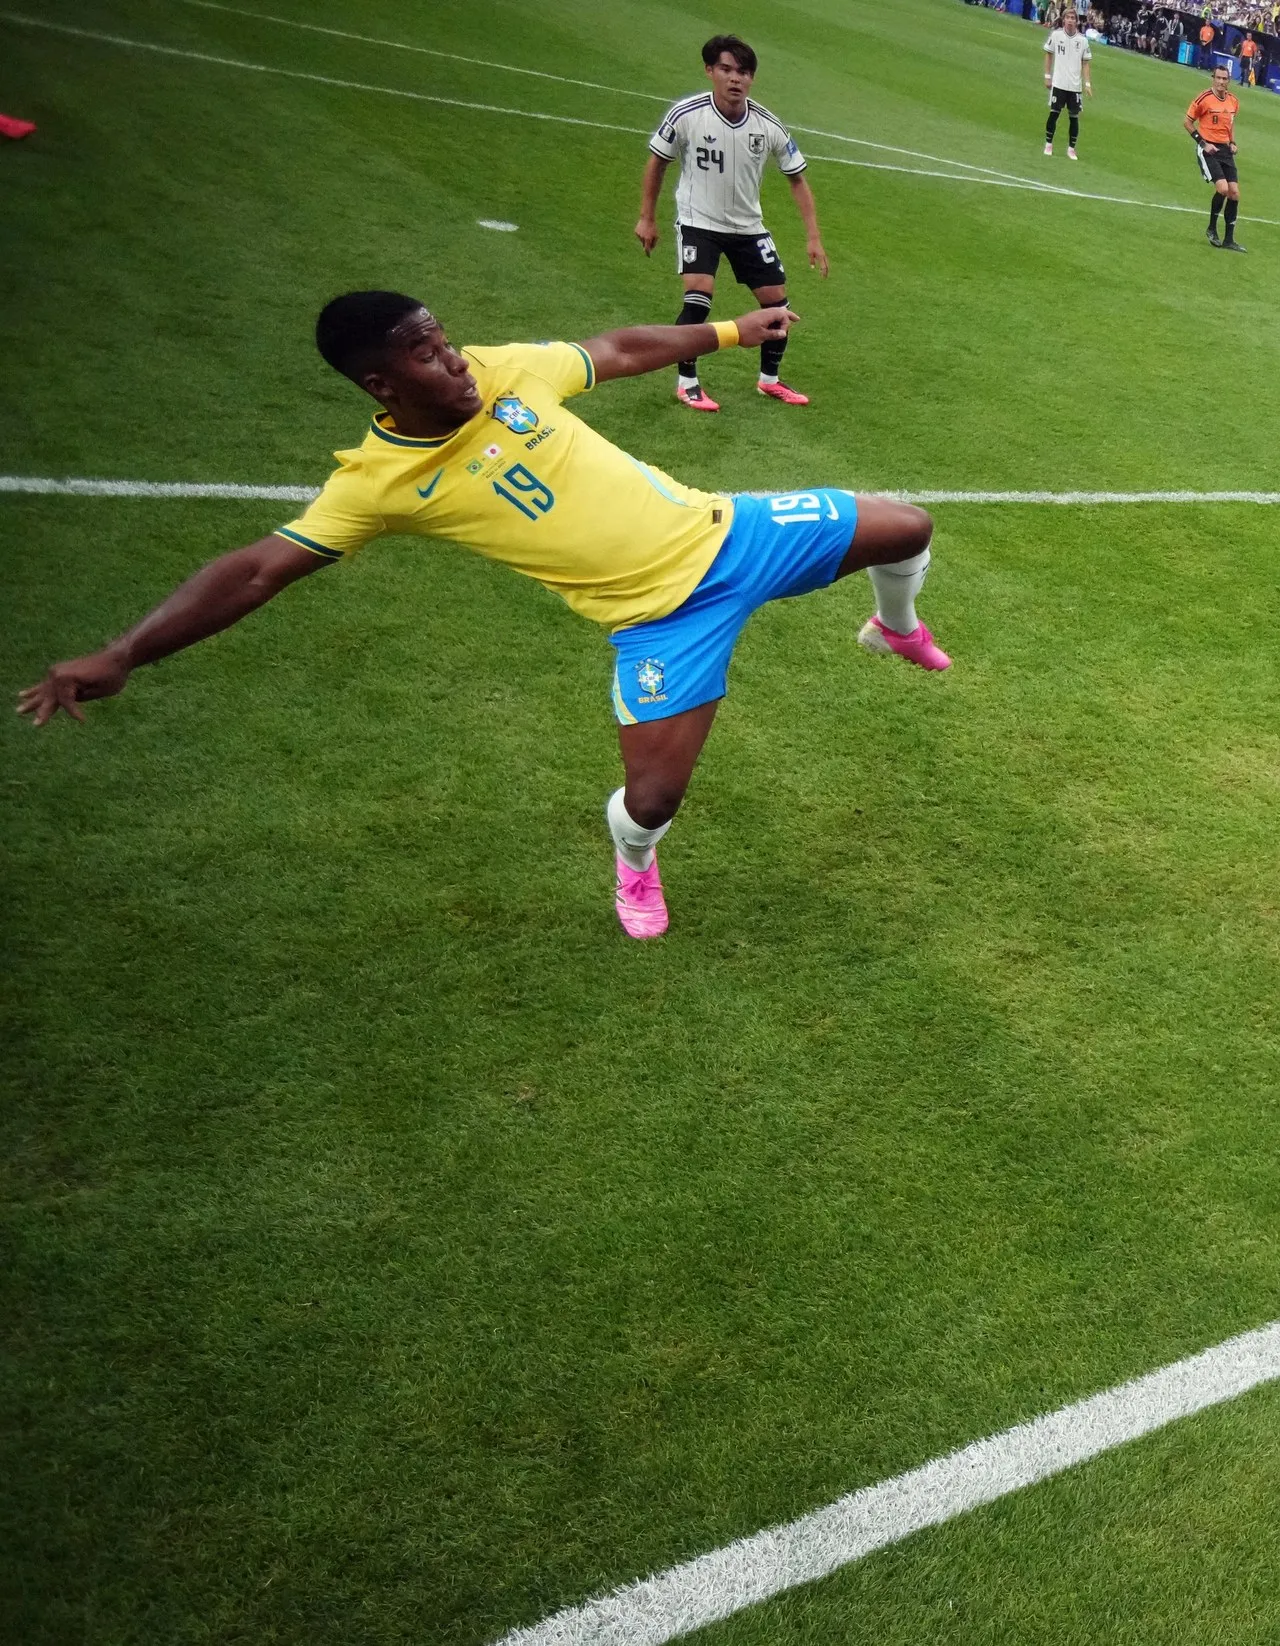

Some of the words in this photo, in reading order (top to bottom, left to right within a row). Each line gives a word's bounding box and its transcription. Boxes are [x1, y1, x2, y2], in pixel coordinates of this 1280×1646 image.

[1057, 45, 1066, 56] 14
[696, 146, 725, 174] 24
[524, 426, 556, 451] BRASIL
[492, 462, 555, 521] 19
[770, 493, 821, 527] 19
[637, 693, 669, 705] BRASIL
